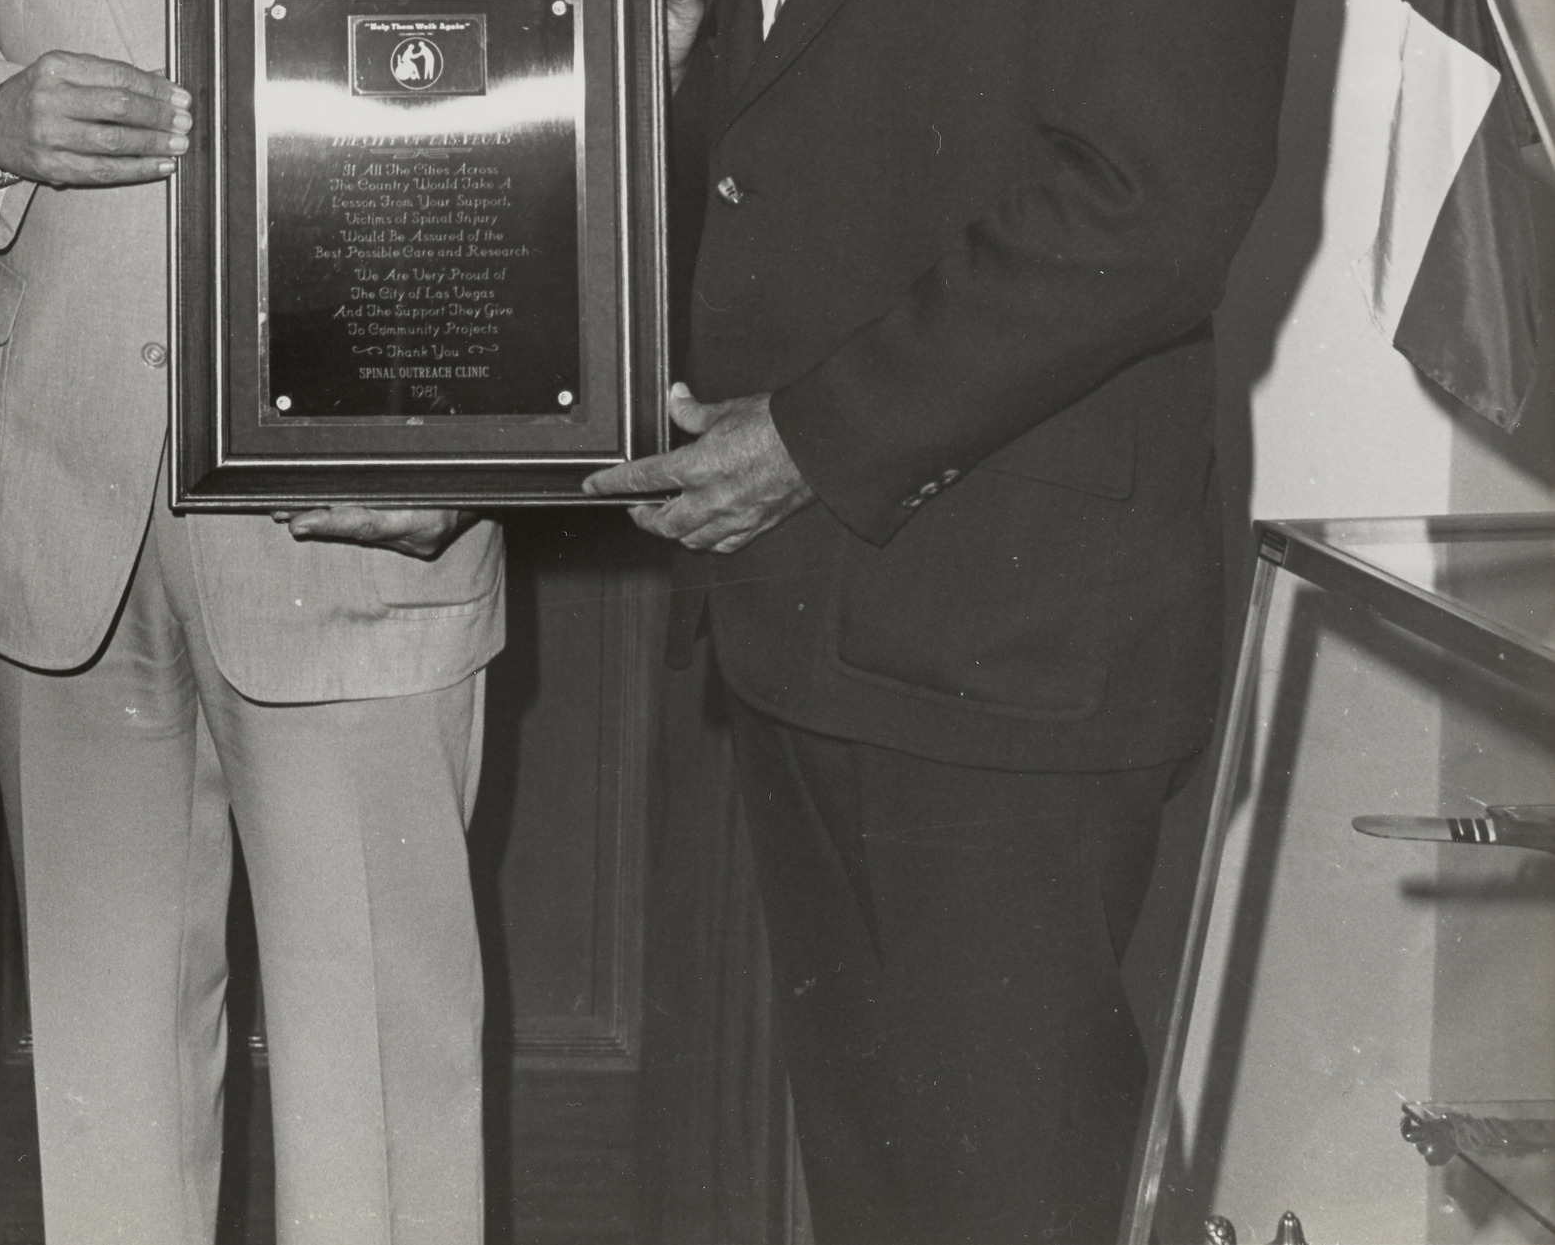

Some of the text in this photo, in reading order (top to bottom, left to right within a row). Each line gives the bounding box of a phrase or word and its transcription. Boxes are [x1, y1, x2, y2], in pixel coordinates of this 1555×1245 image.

[391, 22, 414, 31] Them
[415, 22, 437, 31] Walk
[342, 162, 499, 177] If All The Cities Across
[329, 176, 512, 193] The Country Would Take A
[332, 194, 377, 208] Lesson
[379, 194, 413, 207] From
[417, 194, 450, 210] Your
[345, 212, 498, 227] Victims of Spinal Injury
[340, 229, 504, 243] Would Be Assured of the
[314, 244, 529, 259] Best Possible Care and Research
[354, 267, 507, 283] We Are Very Proud of
[350, 286, 495, 302] The City of Las Vegas
[332, 303, 513, 319] And The Support They Give
[347, 322, 499, 337] To Community Projects
[386, 344, 459, 360] Thank You
[358, 366, 489, 380] SPINAL OUTREACH CLINIC
[411, 385, 438, 398] 1981
